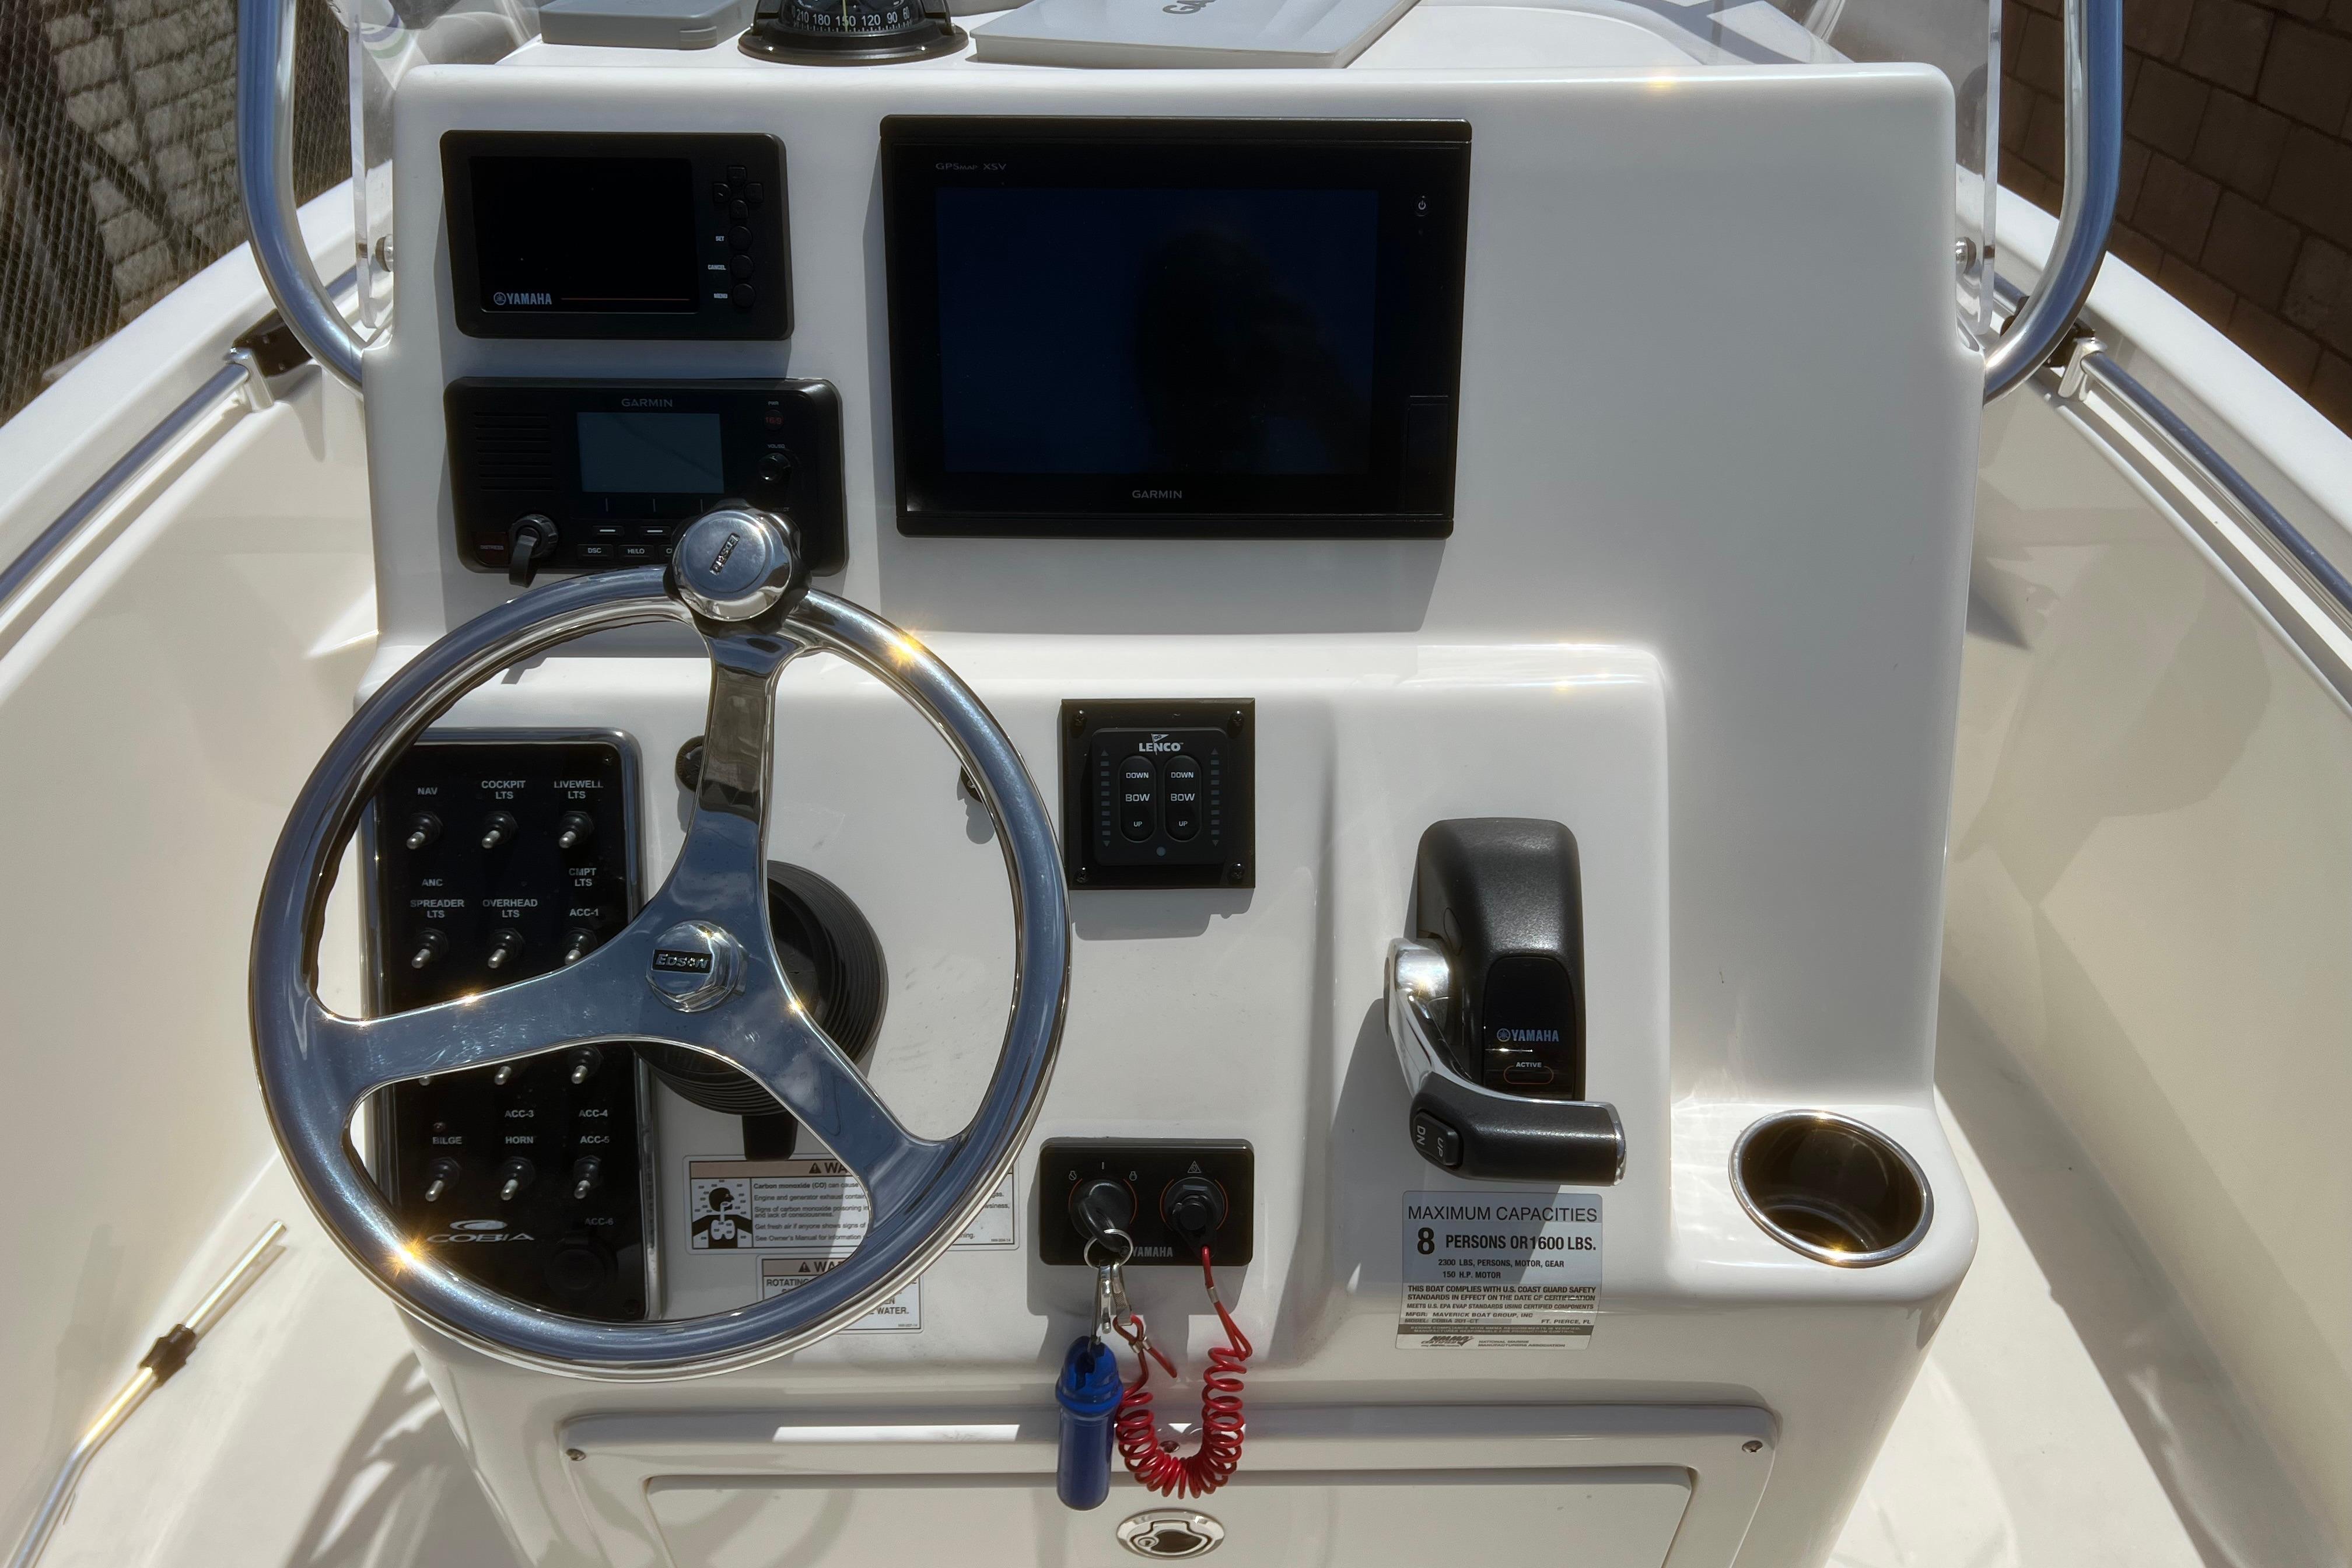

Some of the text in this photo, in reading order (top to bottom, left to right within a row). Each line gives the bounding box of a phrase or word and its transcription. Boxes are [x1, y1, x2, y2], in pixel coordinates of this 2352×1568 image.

[796, 9, 809, 23] 210
[813, 14, 830, 26] 180
[835, 15, 856, 26] 150
[862, 14, 880, 26] 120
[887, 12, 898, 24] 90
[506, 293, 552, 305] YAMAHA
[621, 398, 673, 407] GARMIN
[1132, 490, 1182, 499] GARMIN
[1139, 743, 1181, 752] LENCO
[481, 780, 526, 789] COCKPIT
[418, 787, 438, 795] NAV
[568, 791, 586, 799] LTS
[1170, 793, 1195, 802] BOW
[569, 868, 596, 876] CMPT
[575, 878, 592, 887] LTS
[569, 909, 598, 917] ACC-1
[1511, 1029, 1559, 1042] YAMAHA
[505, 1110, 534, 1118] ACC-3
[579, 1110, 608, 1118] ACC-4
[505, 1136, 534, 1144] HORN
[580, 1136, 610, 1144] ACC-5
[1416, 1125, 1426, 1146] DN
[432, 1136, 462, 1145] BILGE
[1437, 1137, 1444, 1157] UP
[1408, 1206, 1597, 1222] MAXIMUM CAPACITIES
[584, 1217, 614, 1226] ACC-6
[426, 1233, 535, 1243] COBIA
[1418, 1227, 1435, 1255] 8
[1446, 1235, 1506, 1249] PERSONS
[1567, 1237, 1596, 1251] LBS.
[1133, 1246, 1173, 1257] YAMAHA
[1478, 1259, 1513, 1268] PERSONS,
